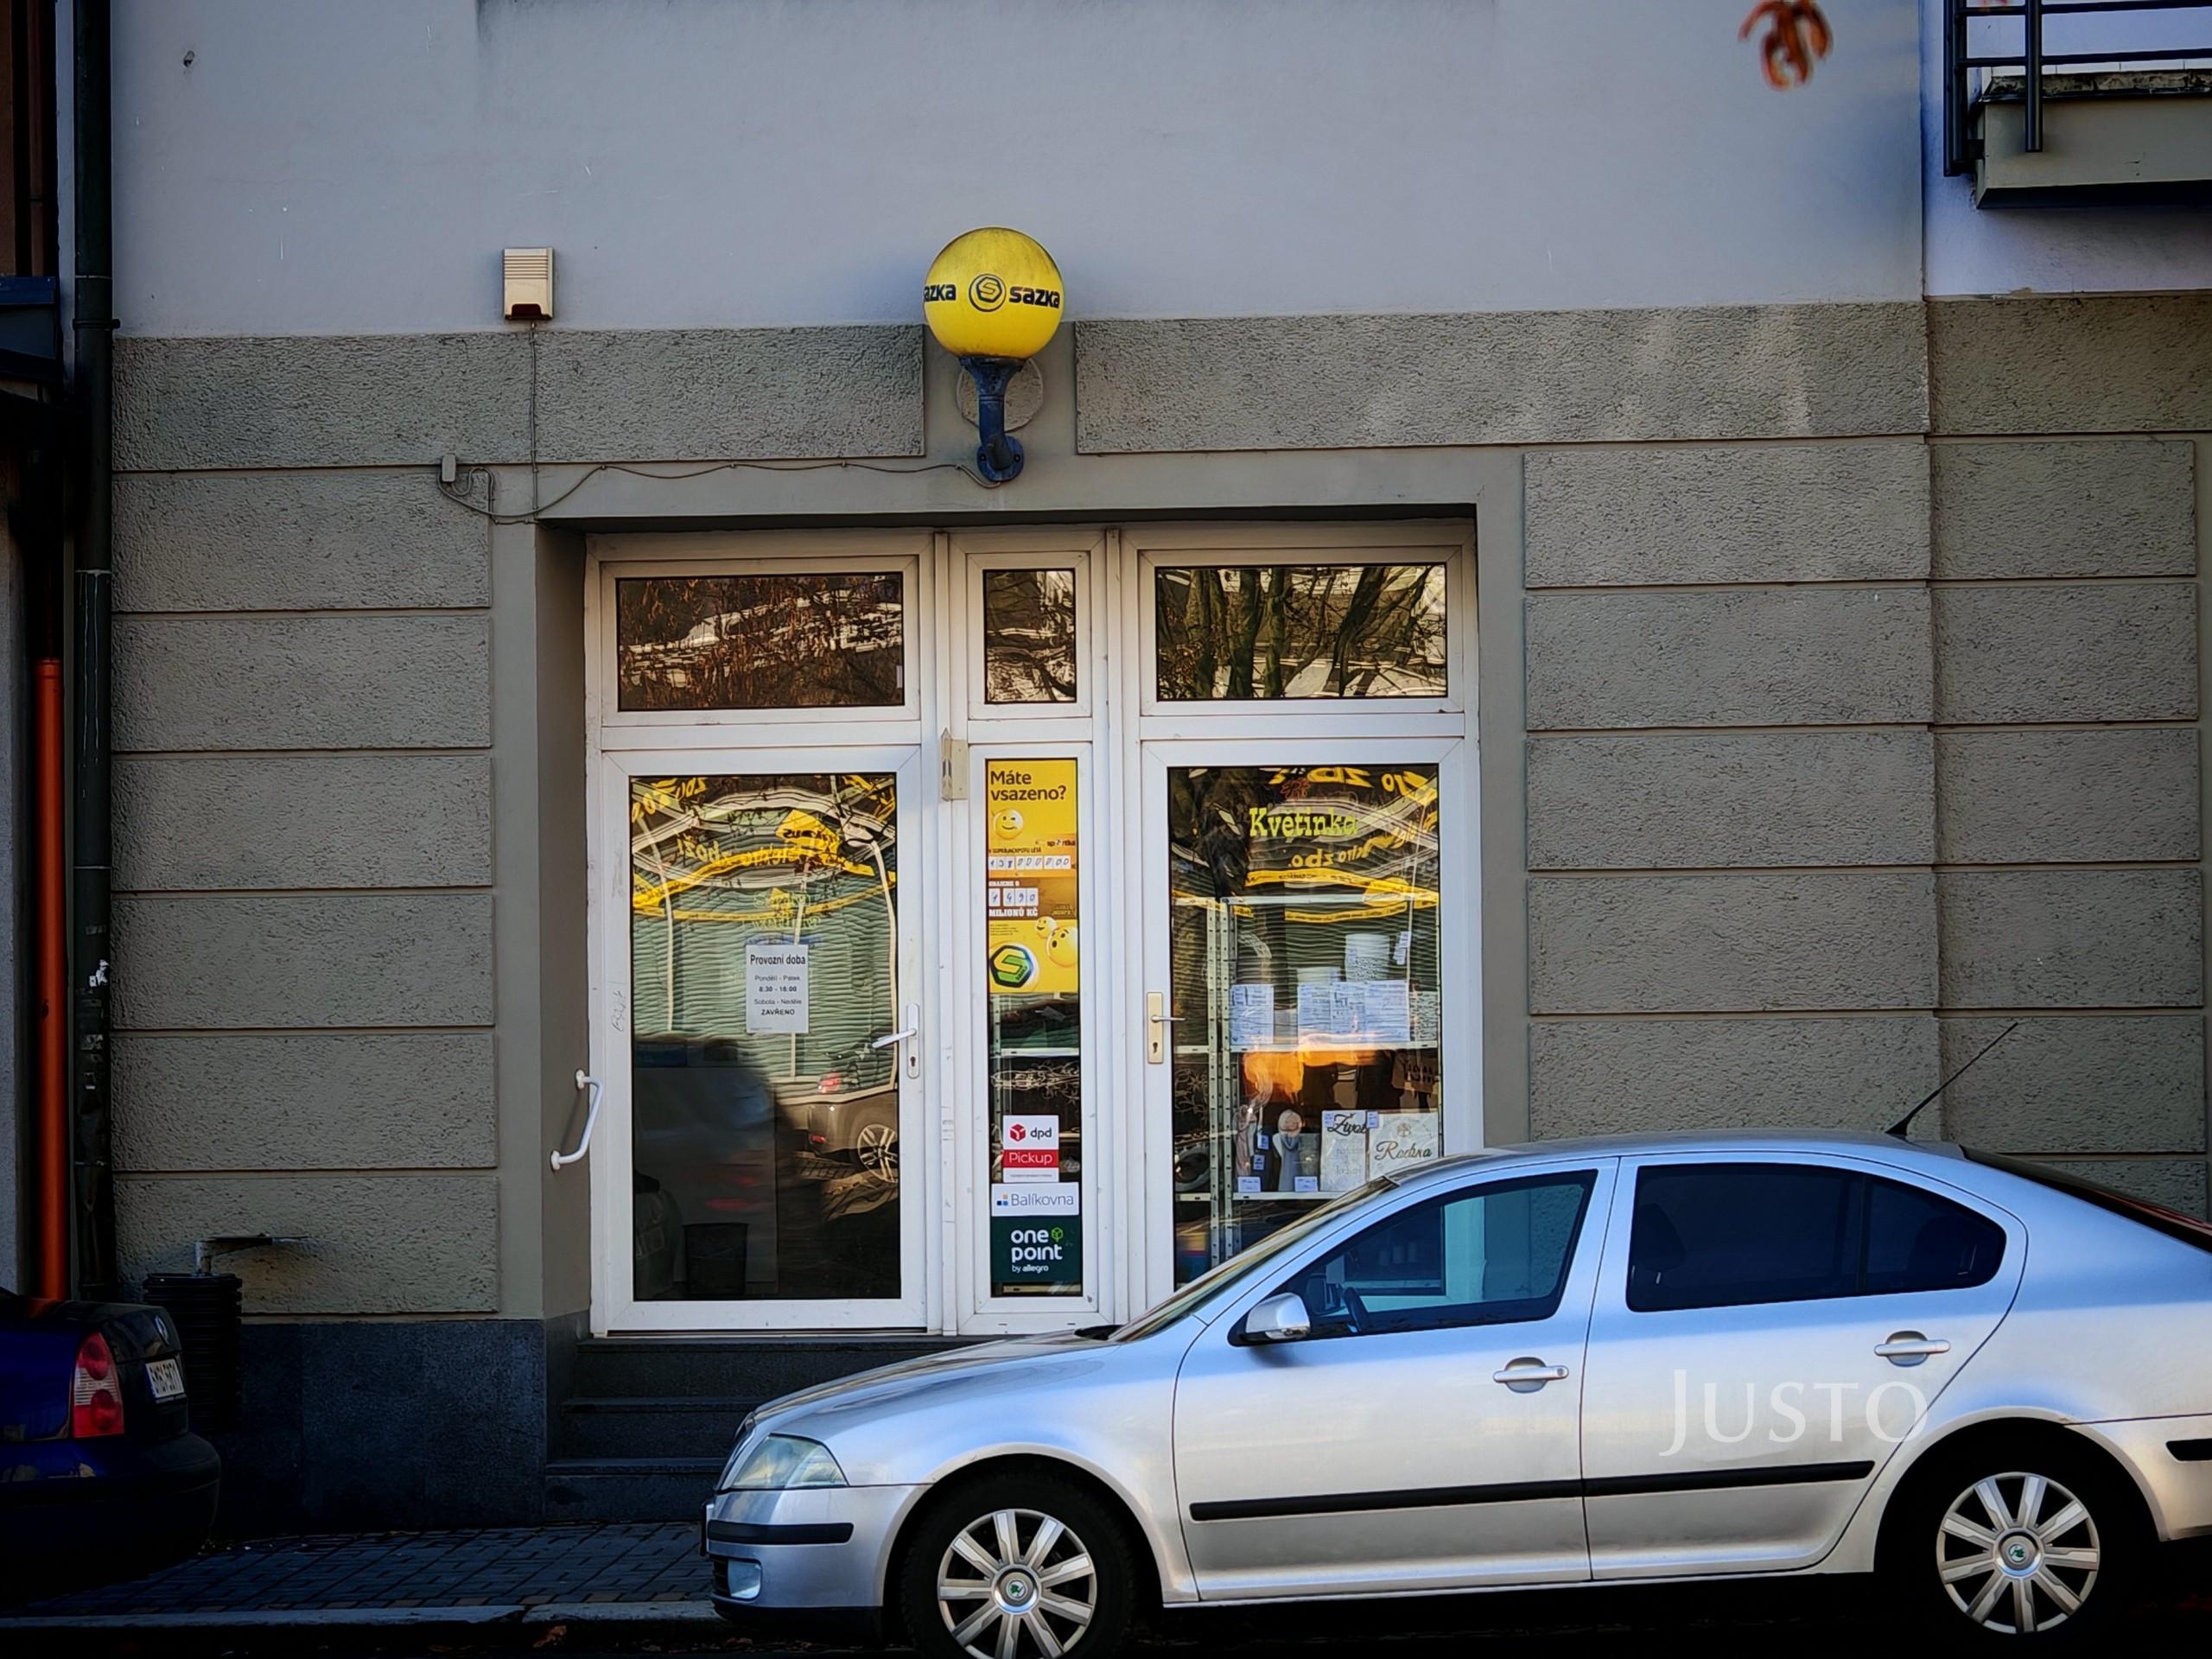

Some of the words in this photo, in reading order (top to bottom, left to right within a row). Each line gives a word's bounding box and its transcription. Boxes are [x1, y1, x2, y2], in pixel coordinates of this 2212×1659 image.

[924, 284, 957, 302] azka
[990, 770, 1032, 785] Máte
[990, 785, 1066, 801] vsazeno?
[1249, 808, 1357, 837] Květinka
[750, 954, 784, 965] Provozní
[786, 954, 805, 964] doba
[1030, 1127, 1052, 1141] dpd
[1008, 1152, 1052, 1165] Pickup
[1011, 1193, 1074, 1206] Balíkovna
[1010, 1230, 1049, 1244] one
[1011, 1244, 1063, 1262] point
[1012, 1264, 1021, 1273] by
[1022, 1264, 1049, 1274] allegro
